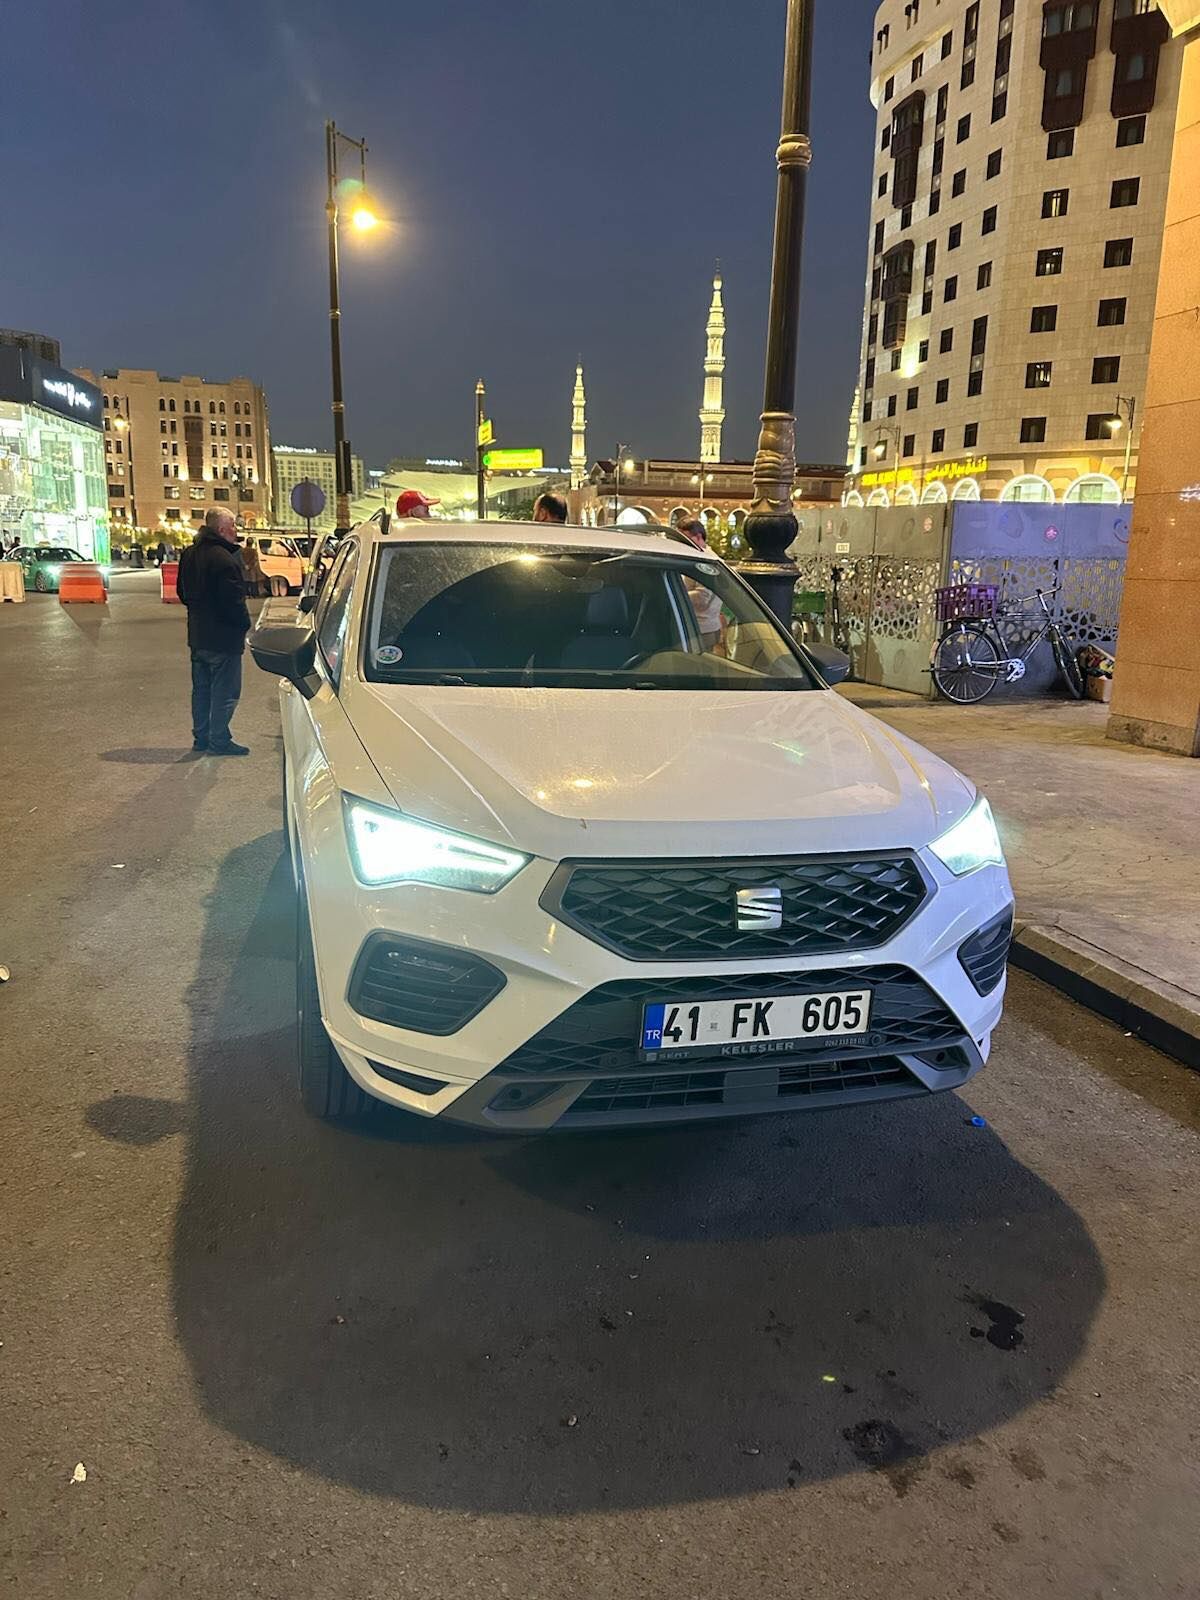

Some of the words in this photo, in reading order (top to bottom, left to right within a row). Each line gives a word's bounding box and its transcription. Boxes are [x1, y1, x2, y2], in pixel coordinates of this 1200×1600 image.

[663, 1006, 700, 1042] 41
[731, 1001, 774, 1037] FK
[802, 995, 863, 1032] 605
[646, 1030, 661, 1040] TR
[721, 1041, 795, 1055] KELESLER
